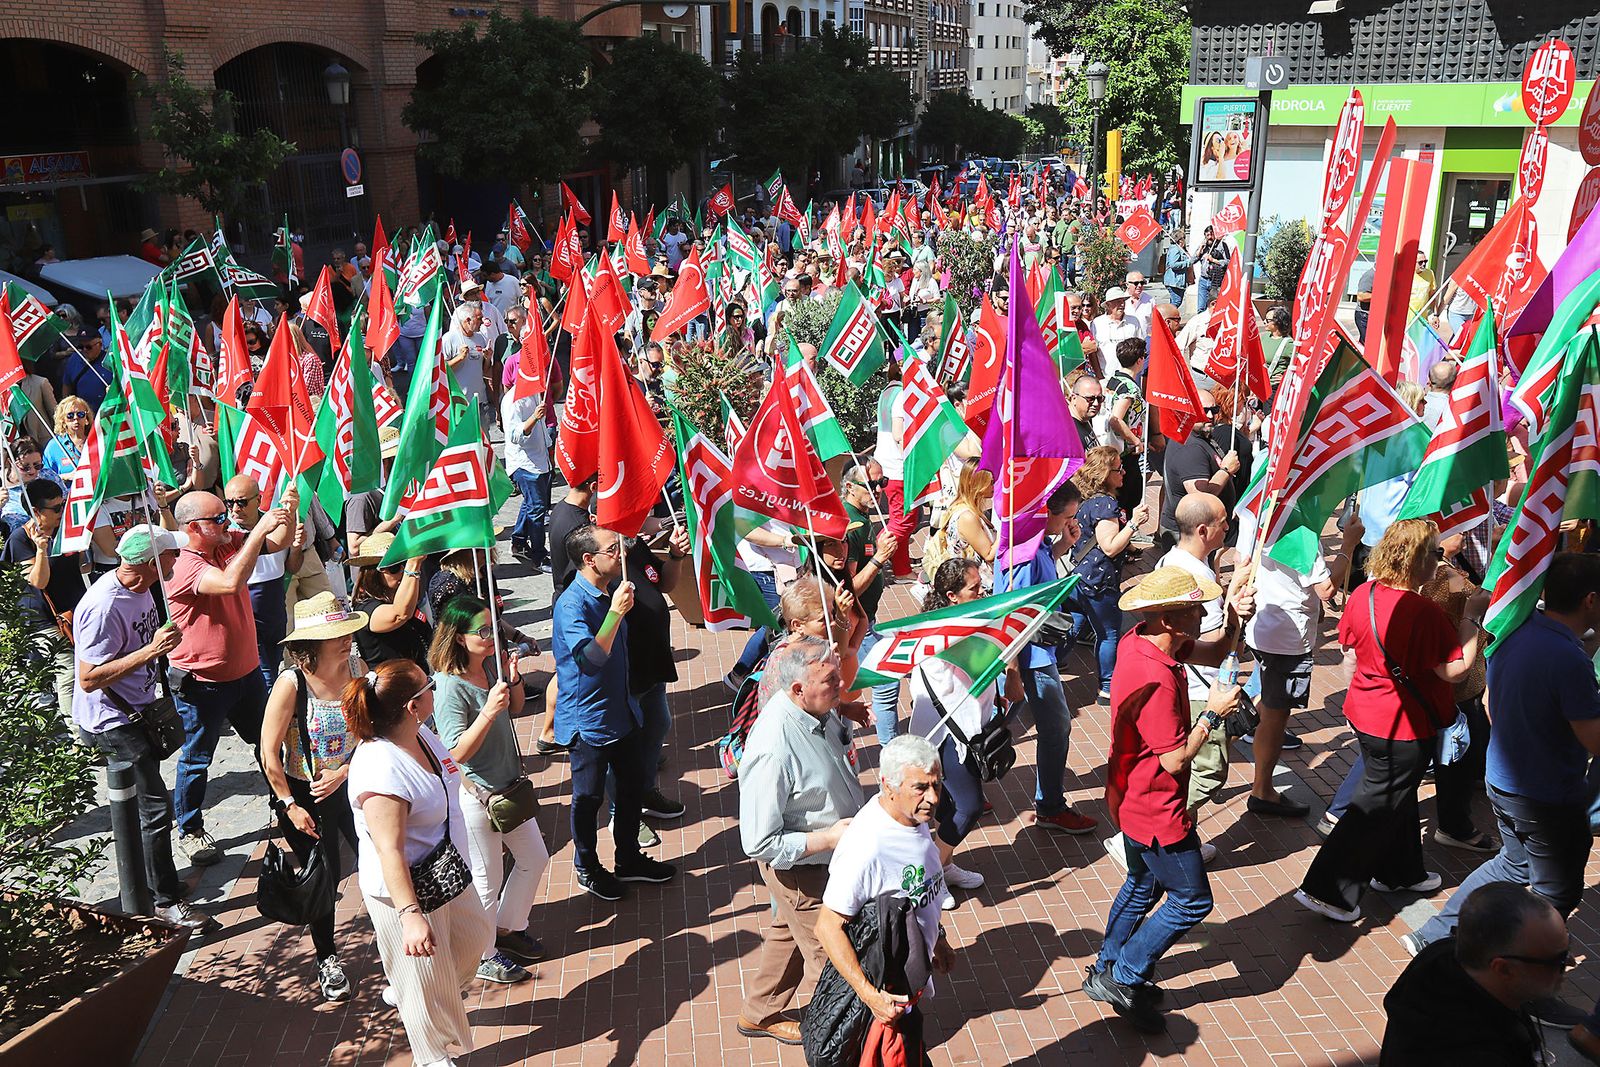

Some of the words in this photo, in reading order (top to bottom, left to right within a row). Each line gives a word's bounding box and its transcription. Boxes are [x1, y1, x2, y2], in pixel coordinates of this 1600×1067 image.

[1530, 49, 1570, 80] UGT
[1272, 100, 1326, 111] RDROLA
[1376, 103, 1413, 111] CLIENTE
[260, 406, 288, 451] andalucia.com
